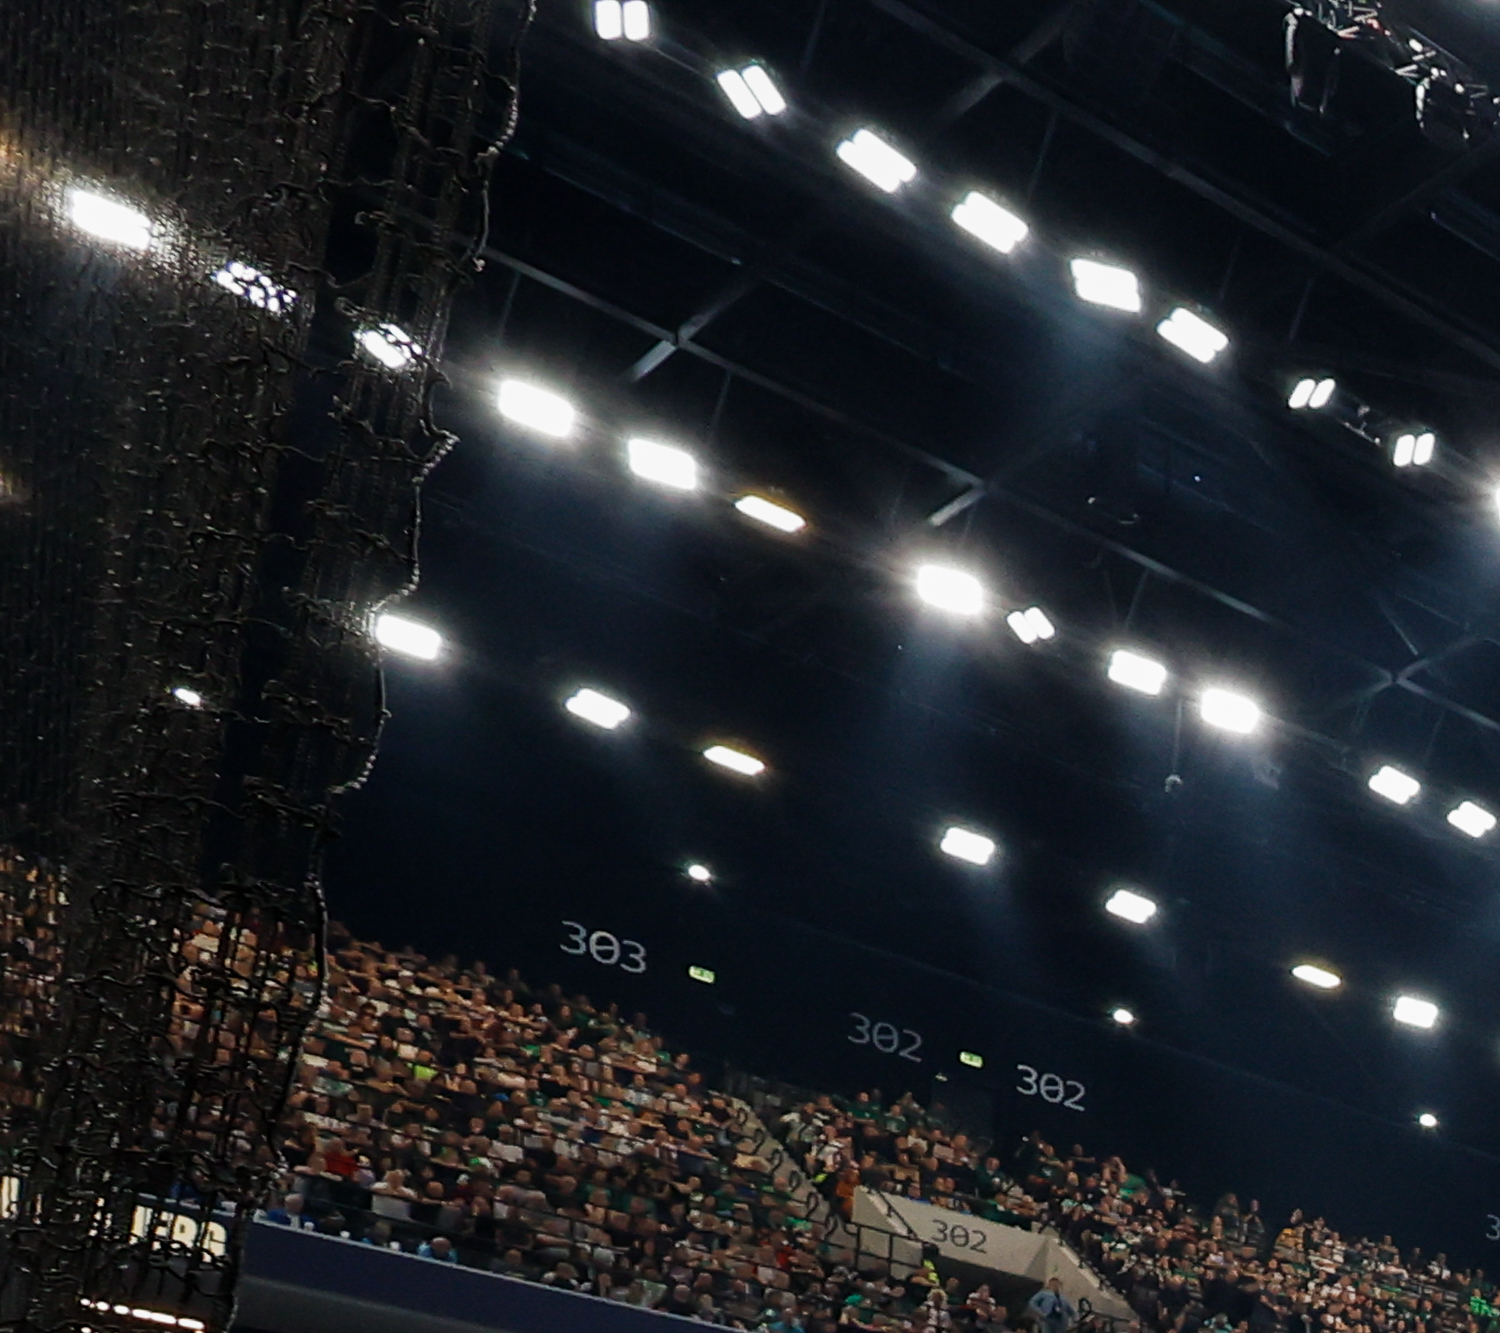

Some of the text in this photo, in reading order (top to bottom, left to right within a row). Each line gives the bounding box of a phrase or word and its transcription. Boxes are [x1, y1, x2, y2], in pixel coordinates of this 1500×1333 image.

[560, 920, 647, 973] 303
[848, 1013, 921, 1062] 302
[931, 1218, 987, 1255] 302
